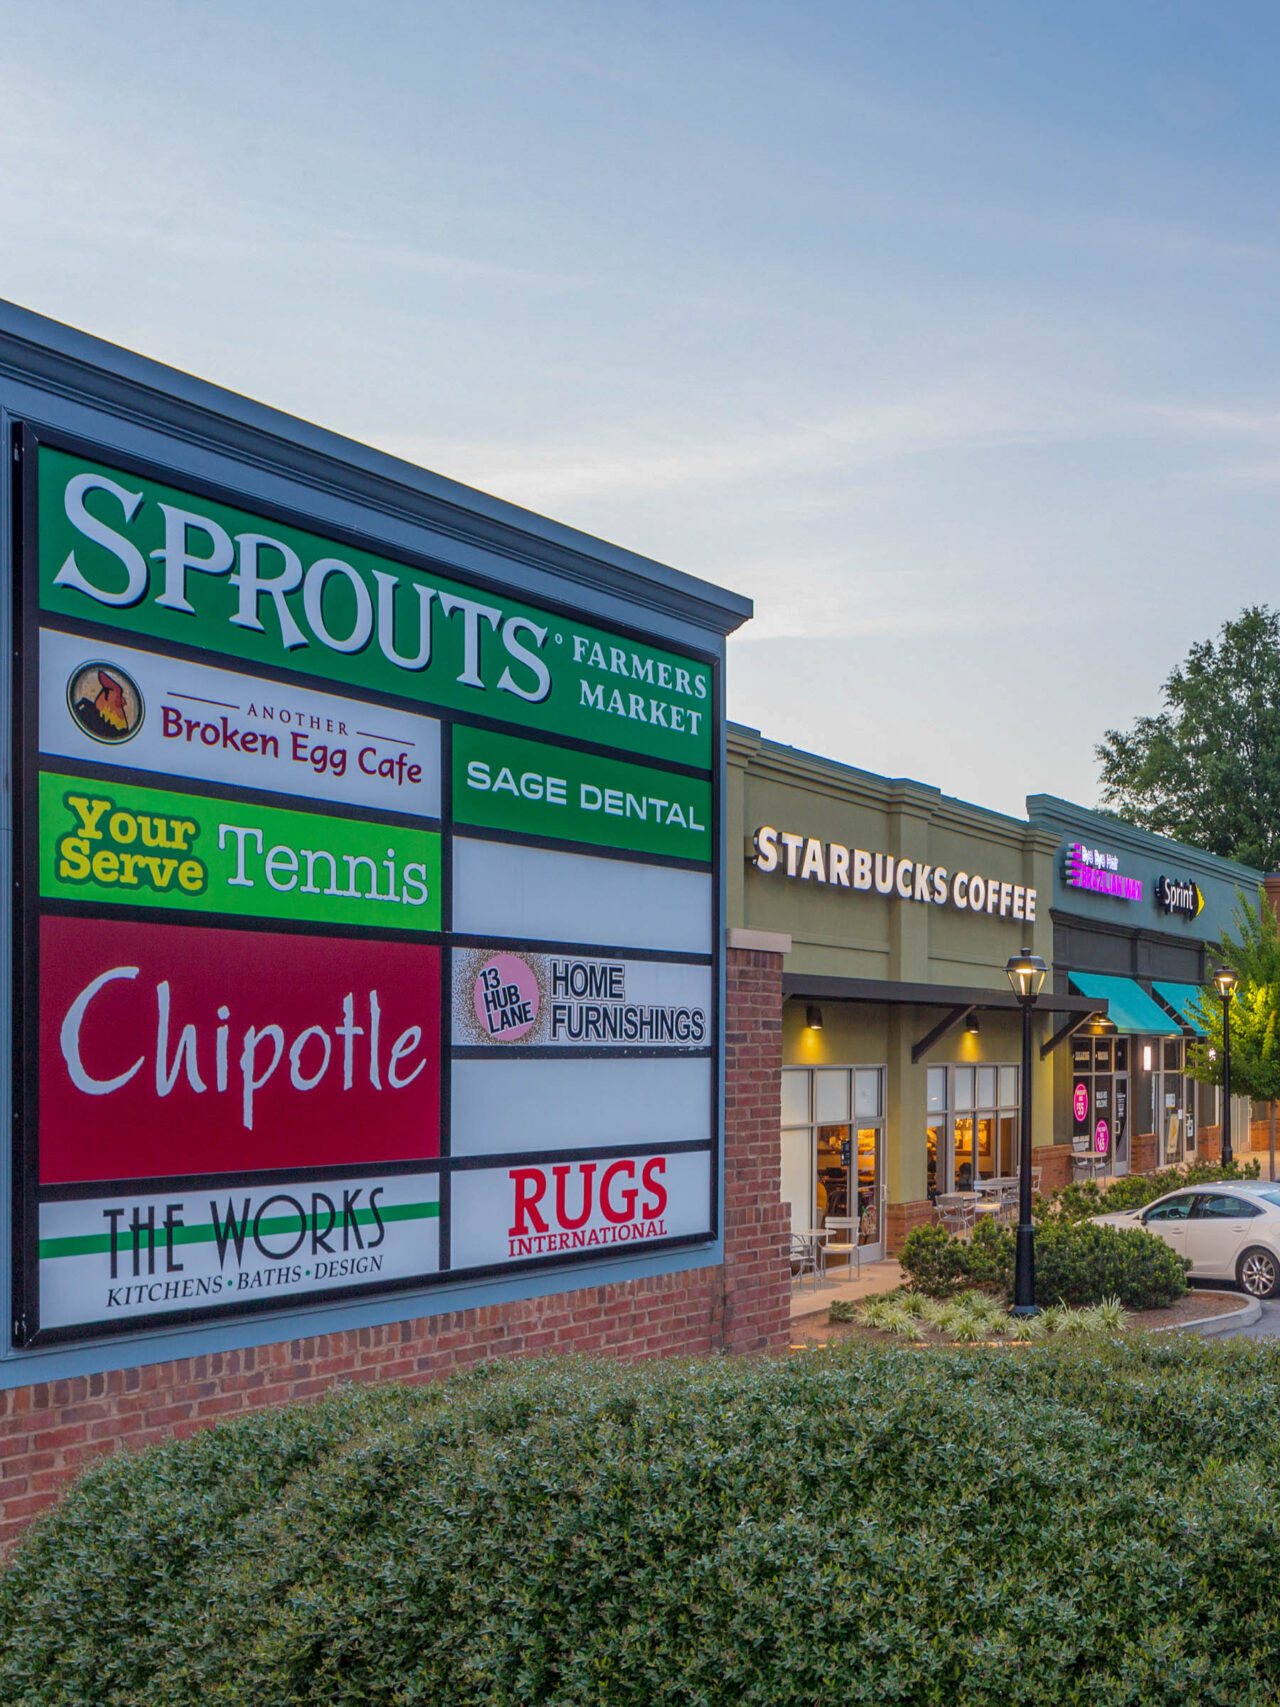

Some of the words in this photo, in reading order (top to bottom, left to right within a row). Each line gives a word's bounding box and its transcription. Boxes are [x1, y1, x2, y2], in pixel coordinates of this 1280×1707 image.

[52, 473, 553, 703] SPROUTS
[572, 634, 707, 700] FARMERS
[247, 703, 348, 735] ANOTHER
[579, 679, 702, 736] MARKET
[161, 706, 279, 759] Broken
[291, 732, 348, 776] Egg
[358, 747, 422, 786] Cafe
[68, 796, 196, 850] Your
[466, 761, 568, 806] SAGE
[580, 784, 706, 832] DENTAL
[60, 837, 204, 890] Serve
[218, 824, 428, 906] Tennis
[755, 826, 948, 905] STARBUCKS
[953, 871, 1038, 923] COFFEE
[1081, 865, 1123, 898] BRAZILIAN
[1124, 876, 1143, 902] WAX
[1164, 878, 1194, 913] Sprint
[480, 969, 501, 992] 13
[483, 984, 521, 1014] HUB
[552, 962, 624, 999] HOME
[487, 1000, 535, 1034] LANE
[551, 1005, 705, 1041] FURNISHINGS
[60, 967, 426, 1131] Chipotle
[508, 1157, 668, 1237] RUGS
[103, 1204, 185, 1279] THE
[210, 1187, 385, 1270] WORKS
[508, 1220, 667, 1257] INTERNATIONAL
[106, 1276, 223, 1308] KITCHENS
[237, 1265, 301, 1290] BATHS
[314, 1255, 383, 1280] DESIGN
